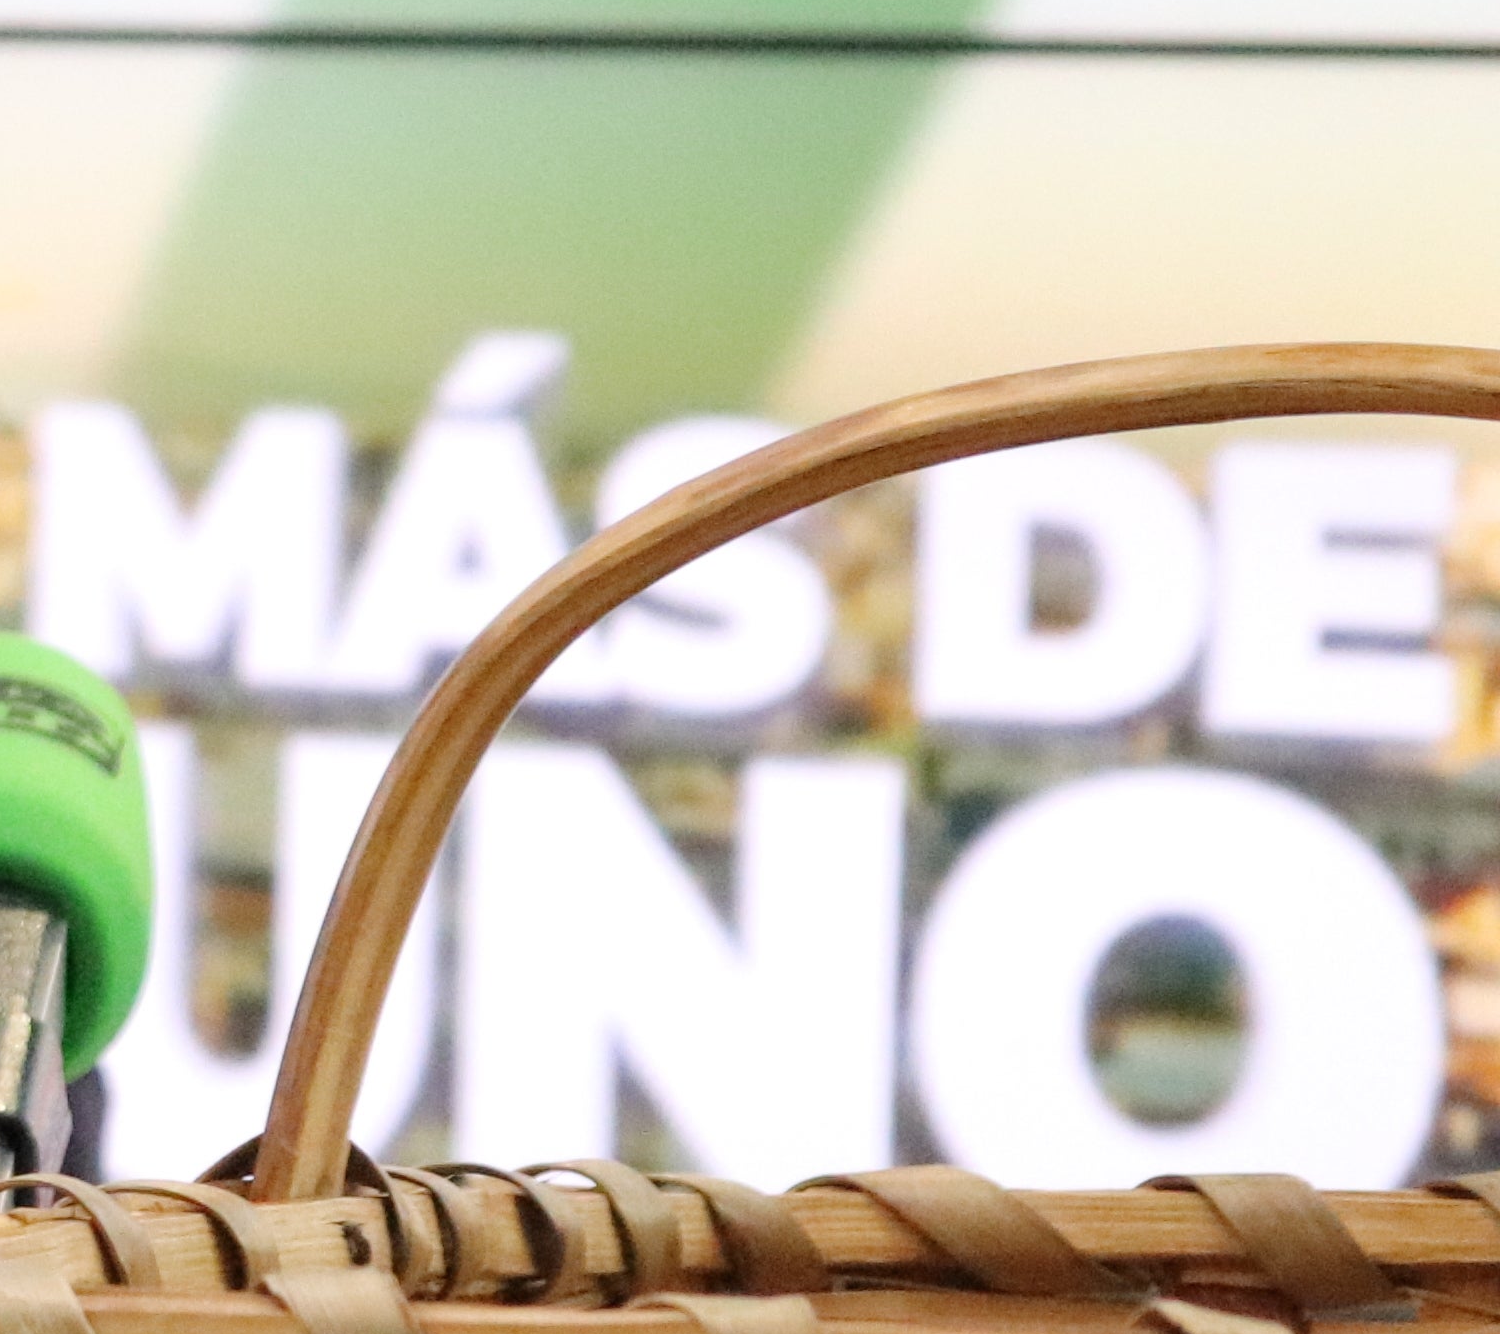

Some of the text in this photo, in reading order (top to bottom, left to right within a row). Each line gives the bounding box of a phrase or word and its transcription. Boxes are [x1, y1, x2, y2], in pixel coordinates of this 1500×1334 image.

[26, 329, 1458, 739] MÁS DE
[104, 719, 1447, 1190] UNO
